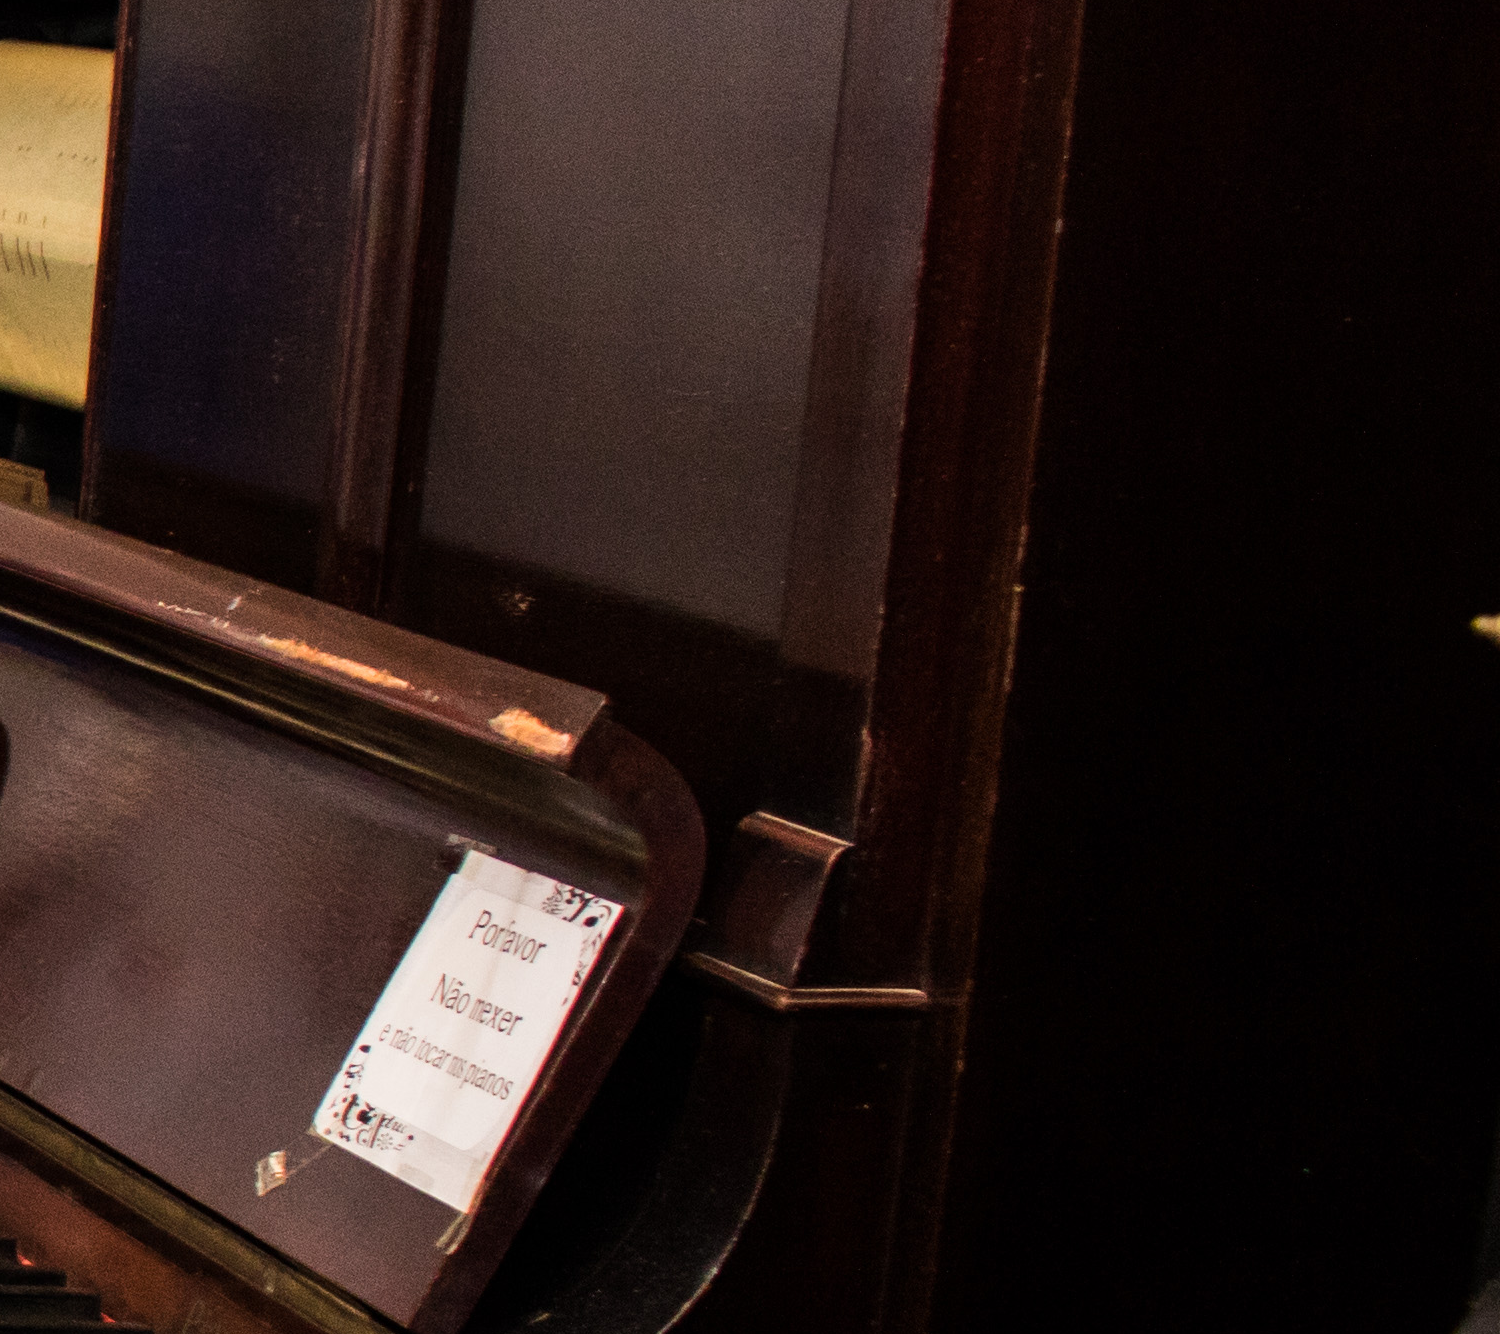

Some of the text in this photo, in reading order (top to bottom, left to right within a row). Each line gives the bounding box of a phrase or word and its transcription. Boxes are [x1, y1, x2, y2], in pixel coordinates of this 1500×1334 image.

[430, 972, 524, 1036] Não mexer
[378, 1023, 392, 1042] e
[389, 1026, 418, 1054] não
[413, 1037, 452, 1070] tocar
[458, 1058, 514, 1101] pianos
